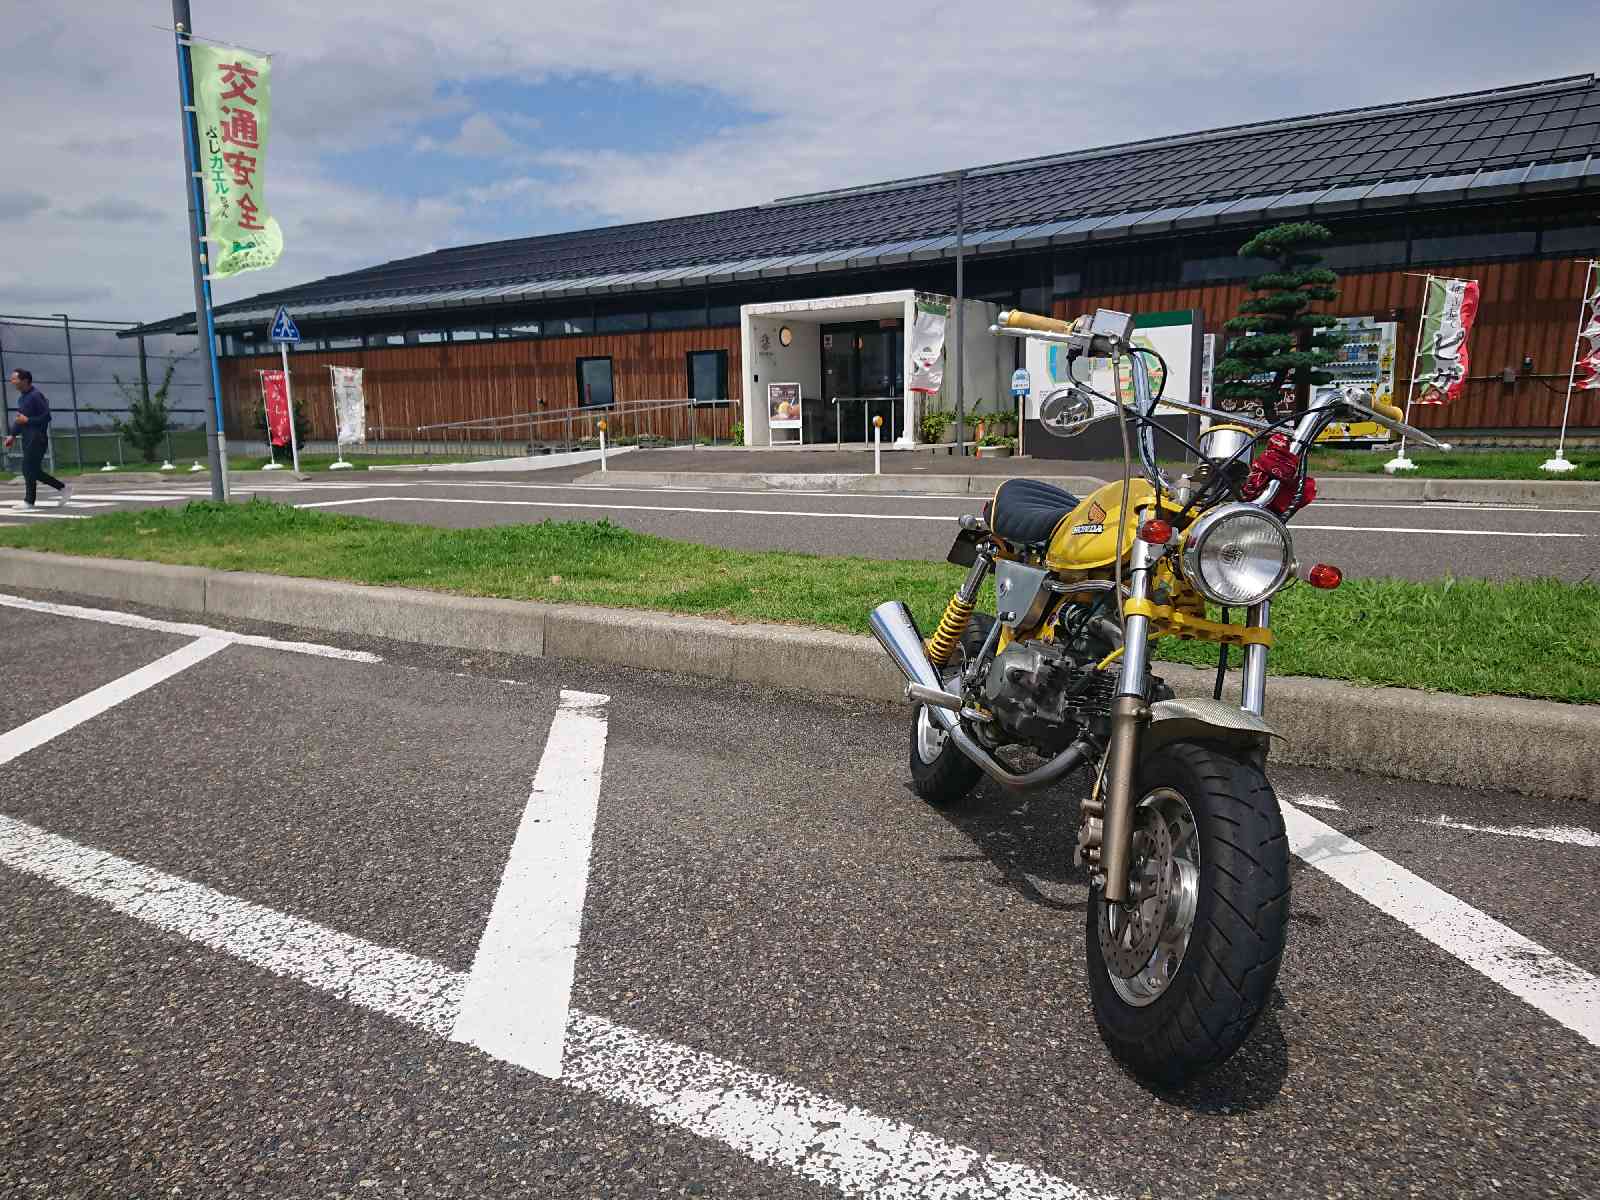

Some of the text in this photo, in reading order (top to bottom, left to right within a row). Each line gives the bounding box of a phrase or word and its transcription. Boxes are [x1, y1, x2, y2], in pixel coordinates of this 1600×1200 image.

[217, 61, 264, 231] 交通安全
[1071, 525, 1104, 534] HONDA
